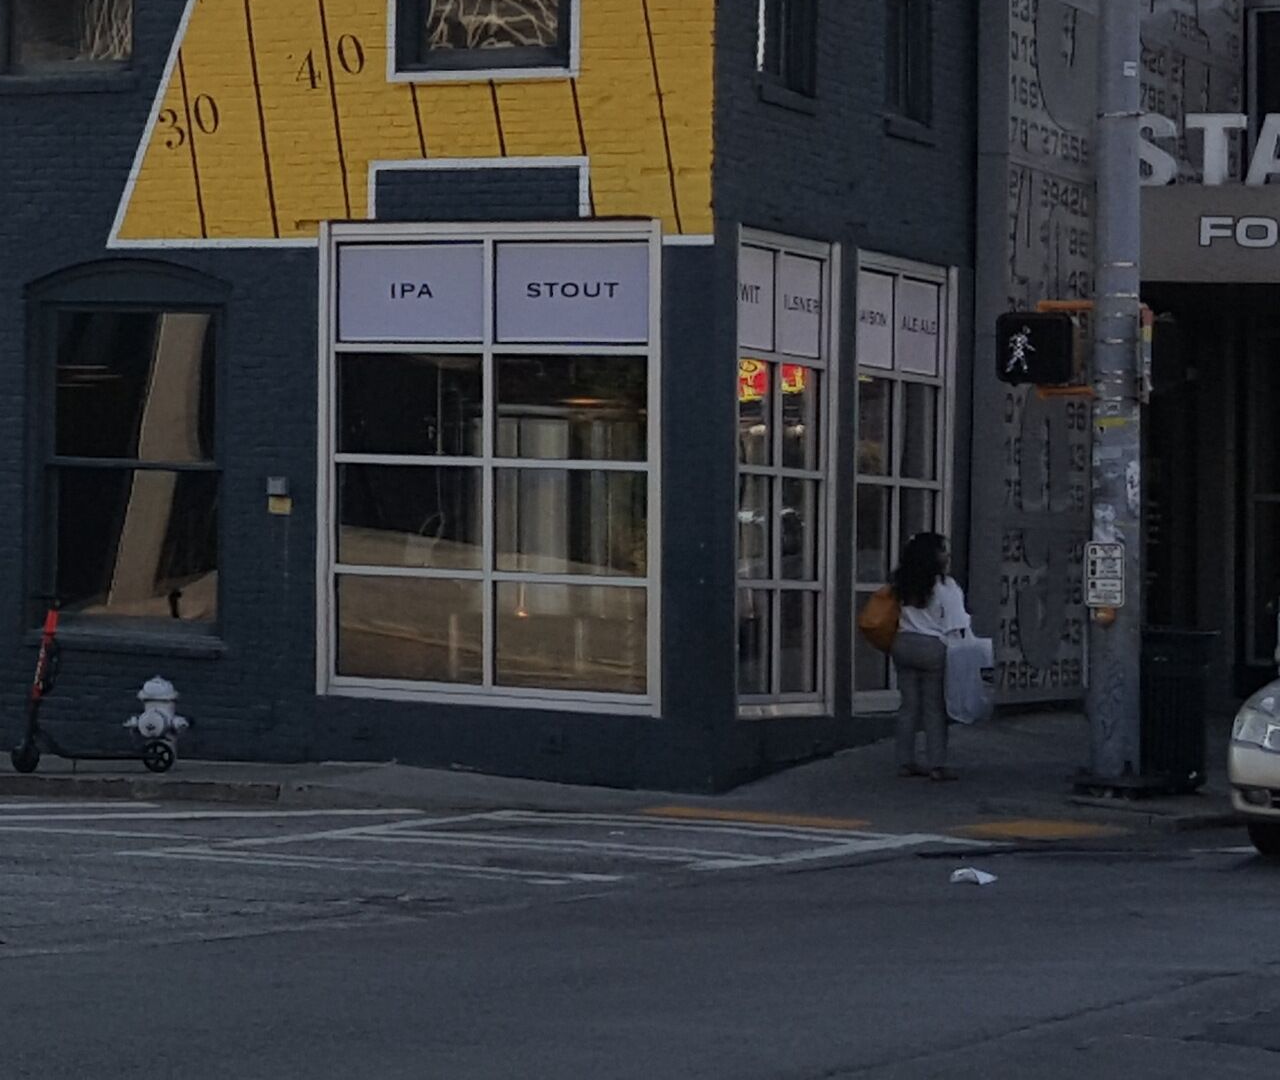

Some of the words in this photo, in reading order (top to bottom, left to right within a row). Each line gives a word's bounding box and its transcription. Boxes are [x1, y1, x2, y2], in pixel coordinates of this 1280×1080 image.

[295, 32, 365, 91] 40
[158, 91, 220, 151] 30
[390, 282, 434, 299] IPA
[526, 281, 620, 299] STOUT
